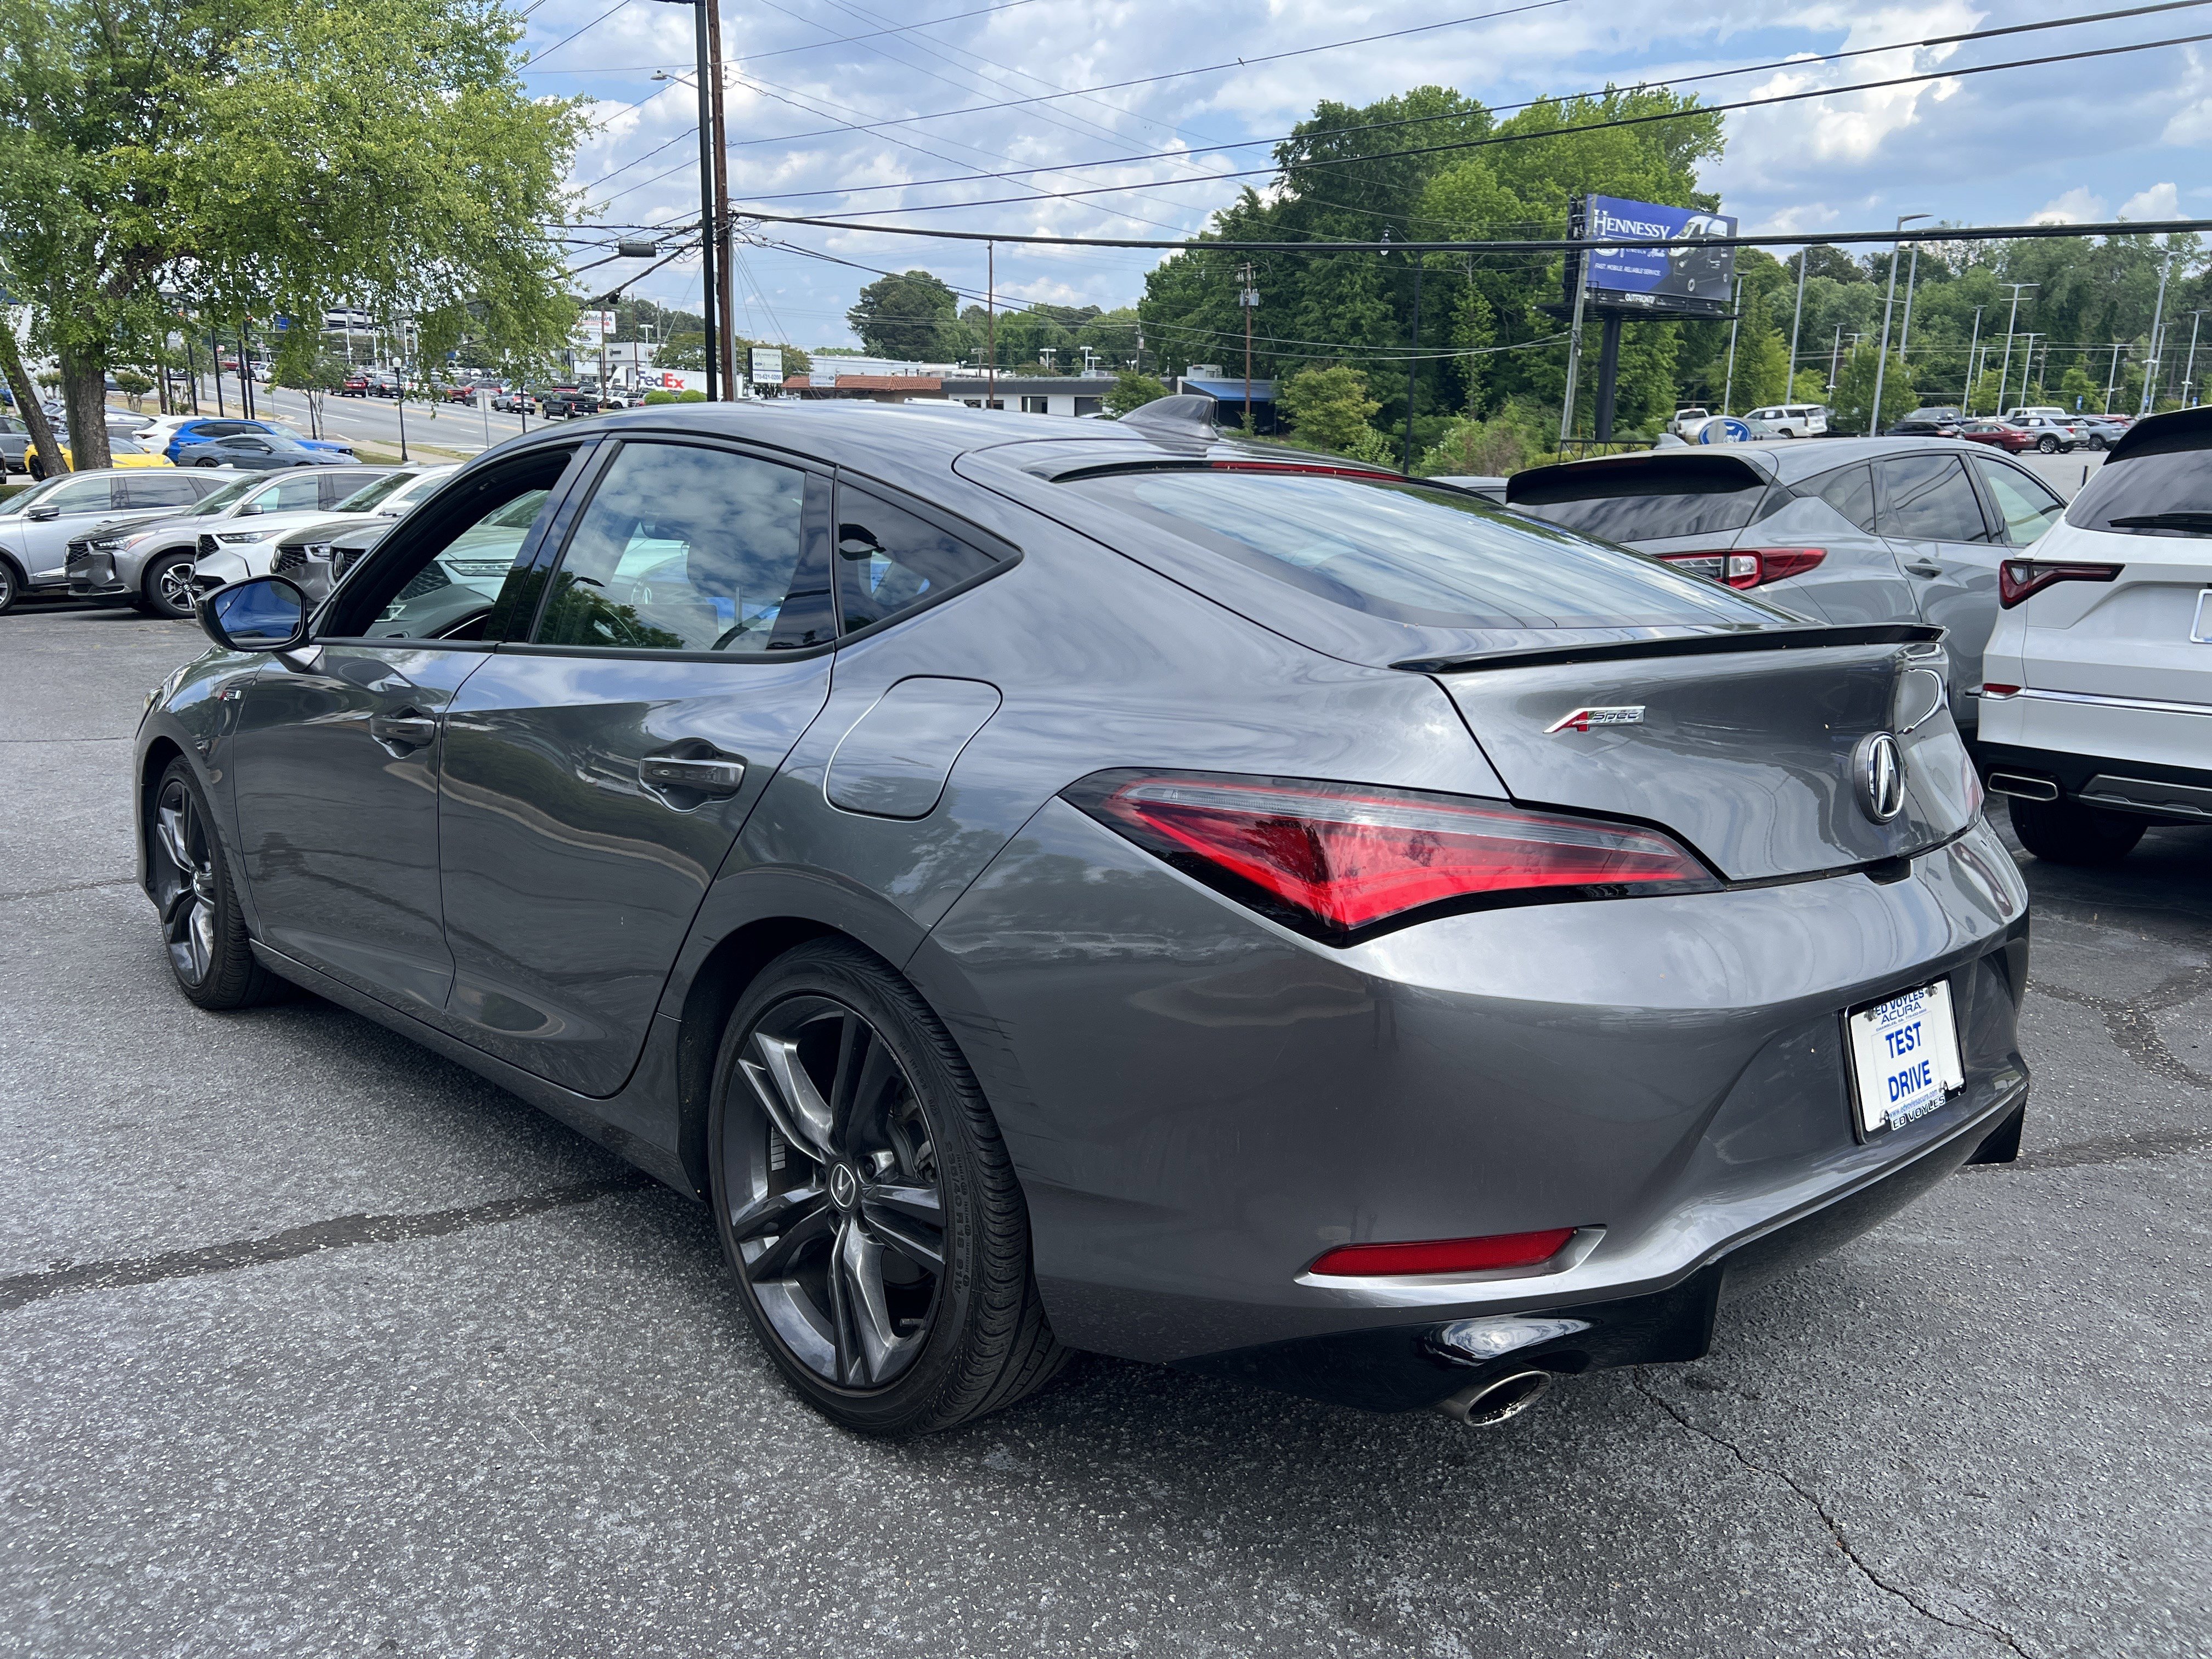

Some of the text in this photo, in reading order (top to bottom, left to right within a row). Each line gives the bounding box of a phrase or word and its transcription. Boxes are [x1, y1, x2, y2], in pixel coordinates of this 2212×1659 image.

[1593, 208, 1671, 240] HENNESSY
[639, 370, 685, 390] FedEx
[1876, 989, 1924, 1015] ED VOYLES
[1881, 1001, 1922, 1025] ACURA
[1885, 1021, 1921, 1059] TEST
[1888, 1059, 1932, 1103] DRIVE
[1893, 1096, 1945, 1128] ED VOYLES
